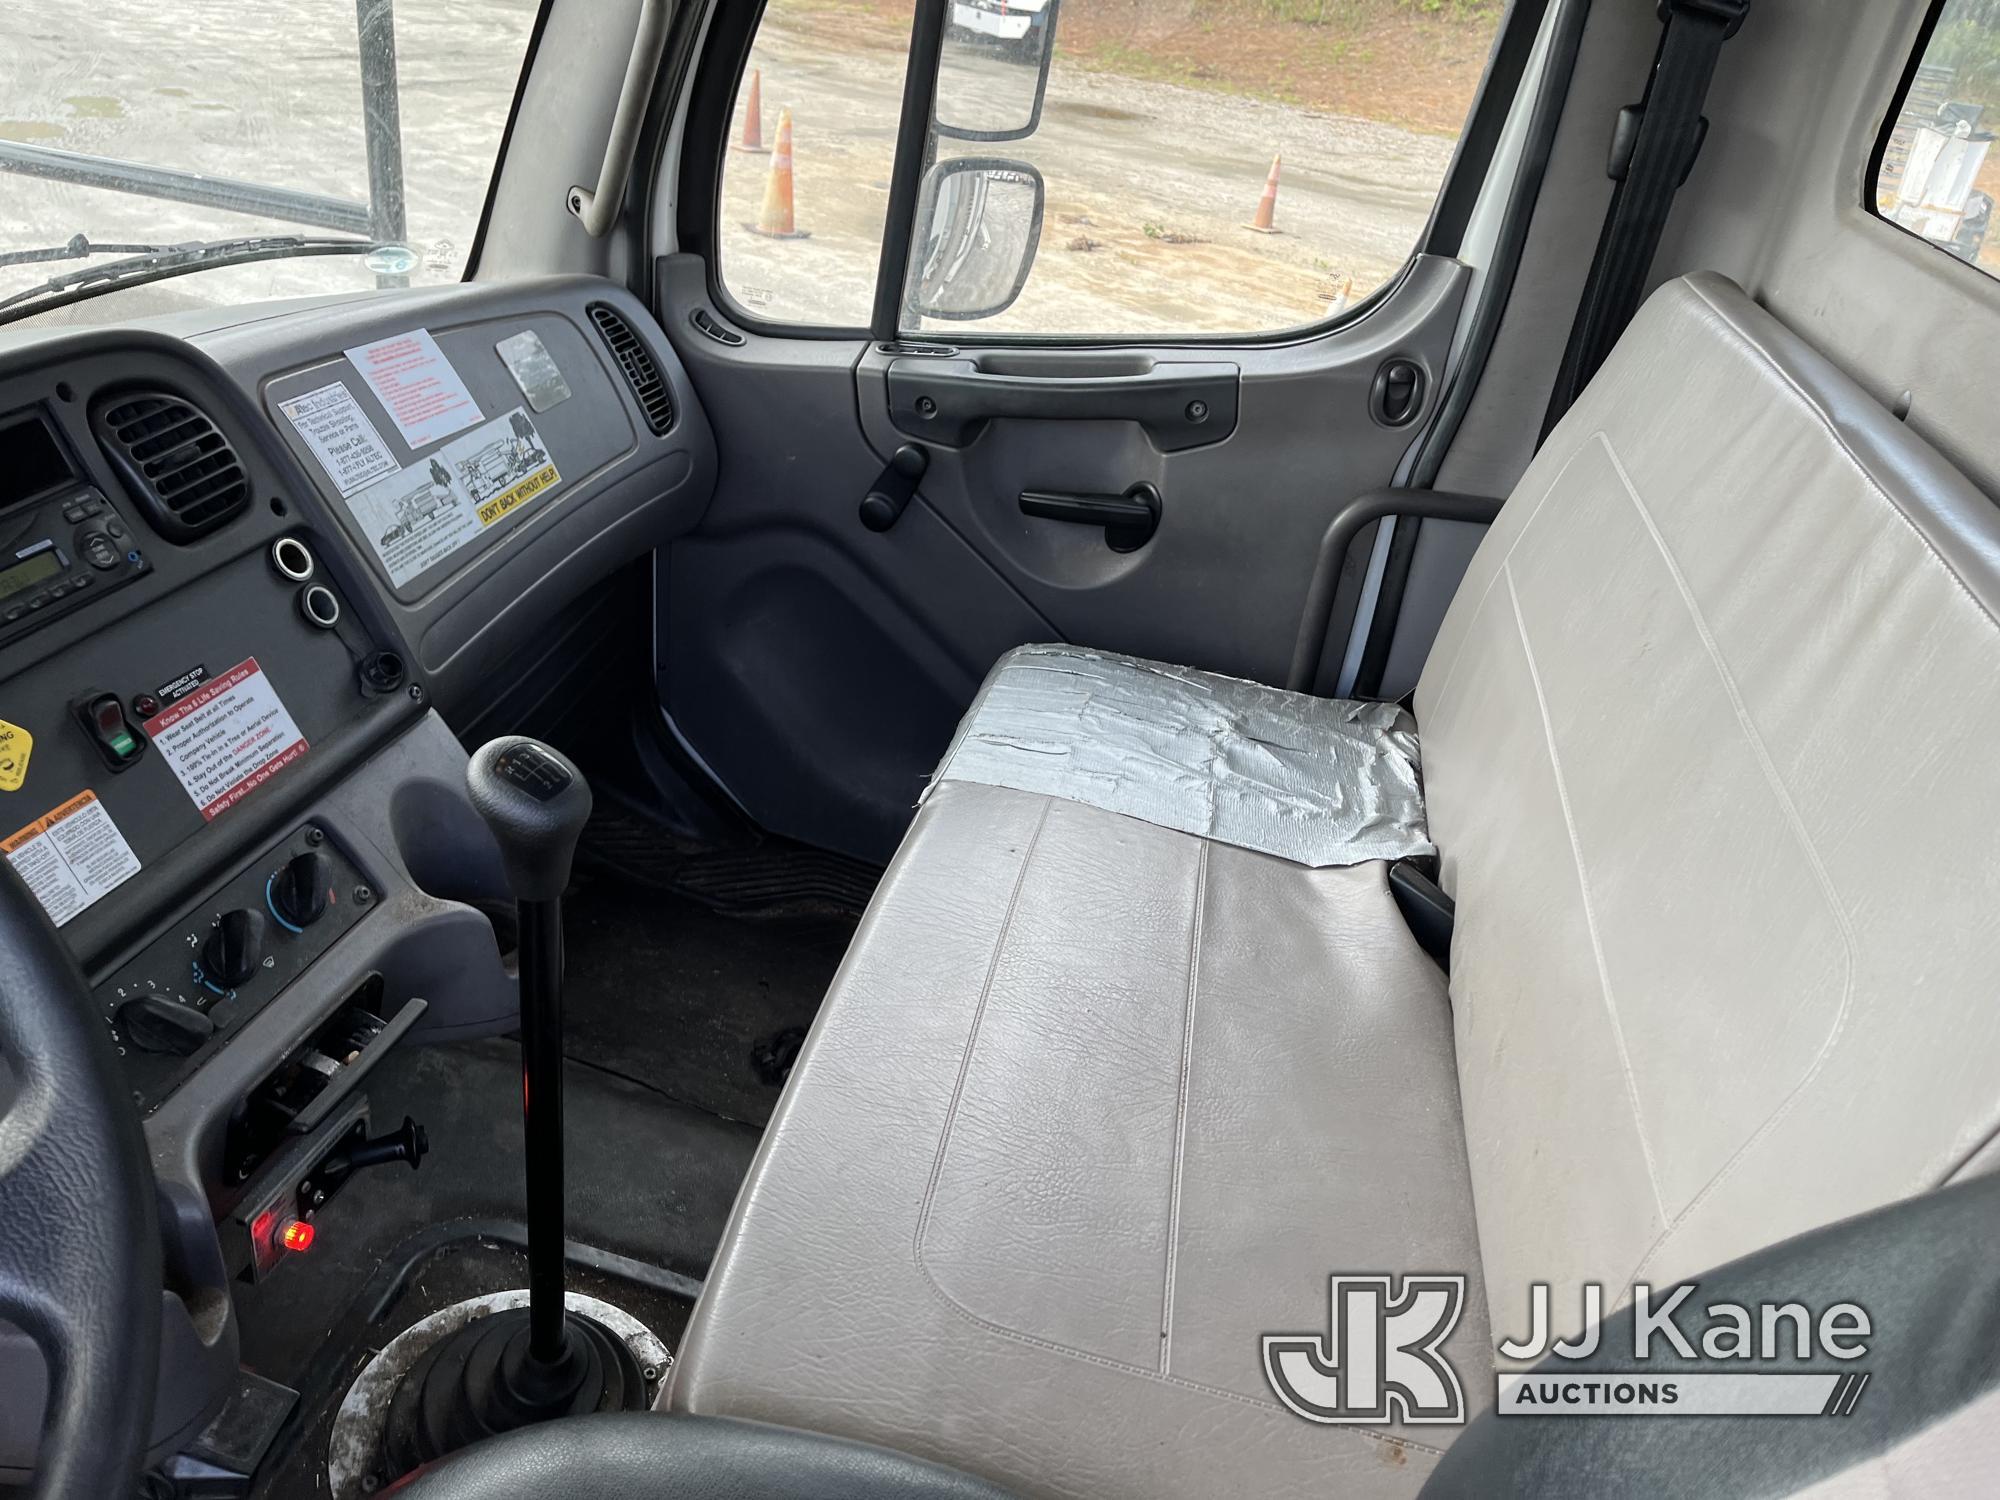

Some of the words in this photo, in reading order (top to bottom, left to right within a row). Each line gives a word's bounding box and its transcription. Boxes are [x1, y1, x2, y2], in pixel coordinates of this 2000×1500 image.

[477, 501, 503, 522] DON'T
[496, 492, 518, 510] BACK
[512, 476, 543, 499] WITHOUT
[537, 467, 557, 484] HELP!
[158, 675, 190, 696] EMERGENCY
[188, 666, 204, 679] STOP
[159, 710, 180, 727] Know
[178, 702, 193, 715] The
[196, 690, 211, 704] Life
[208, 678, 233, 697] Saving
[230, 669, 250, 684] Rules
[171, 678, 199, 698] ACTIVATED
[164, 727, 182, 741] Wear
[179, 719, 194, 732] Seat
[193, 712, 207, 724] Belt
[218, 694, 236, 708] Times
[171, 735, 193, 752] Proper
[191, 712, 228, 739] Authorization
[232, 695, 255, 713] Operate
[185, 758, 202, 772] 100%
[226, 732, 241, 744] Tree
[246, 718, 262, 732] Aerial
[260, 707, 279, 722] Device
[178, 741, 207, 763] Company
[204, 728, 226, 745] Vehicle
[192, 769, 208, 784] Stay
[204, 762, 217, 774] Out
[221, 752, 233, 762] the
[231, 736, 256, 755] DANGER
[254, 726, 271, 740] ZONE
[198, 782, 209, 792] Do
[207, 775, 220, 786] Not
[217, 764, 235, 779] Break
[234, 748, 259, 768] Minimum
[257, 730, 285, 752] Separation
[205, 792, 215, 802] Do
[214, 784, 226, 796] Not
[224, 772, 244, 789] Violate
[242, 766, 253, 776] the
[251, 756, 267, 770] Drop
[264, 747, 279, 760] Zone
[208, 797, 231, 817] Safety
[255, 769, 270, 782] One
[268, 758, 284, 773] Gets
[117, 987, 126, 997] 2
[178, 994, 186, 1002] 4
